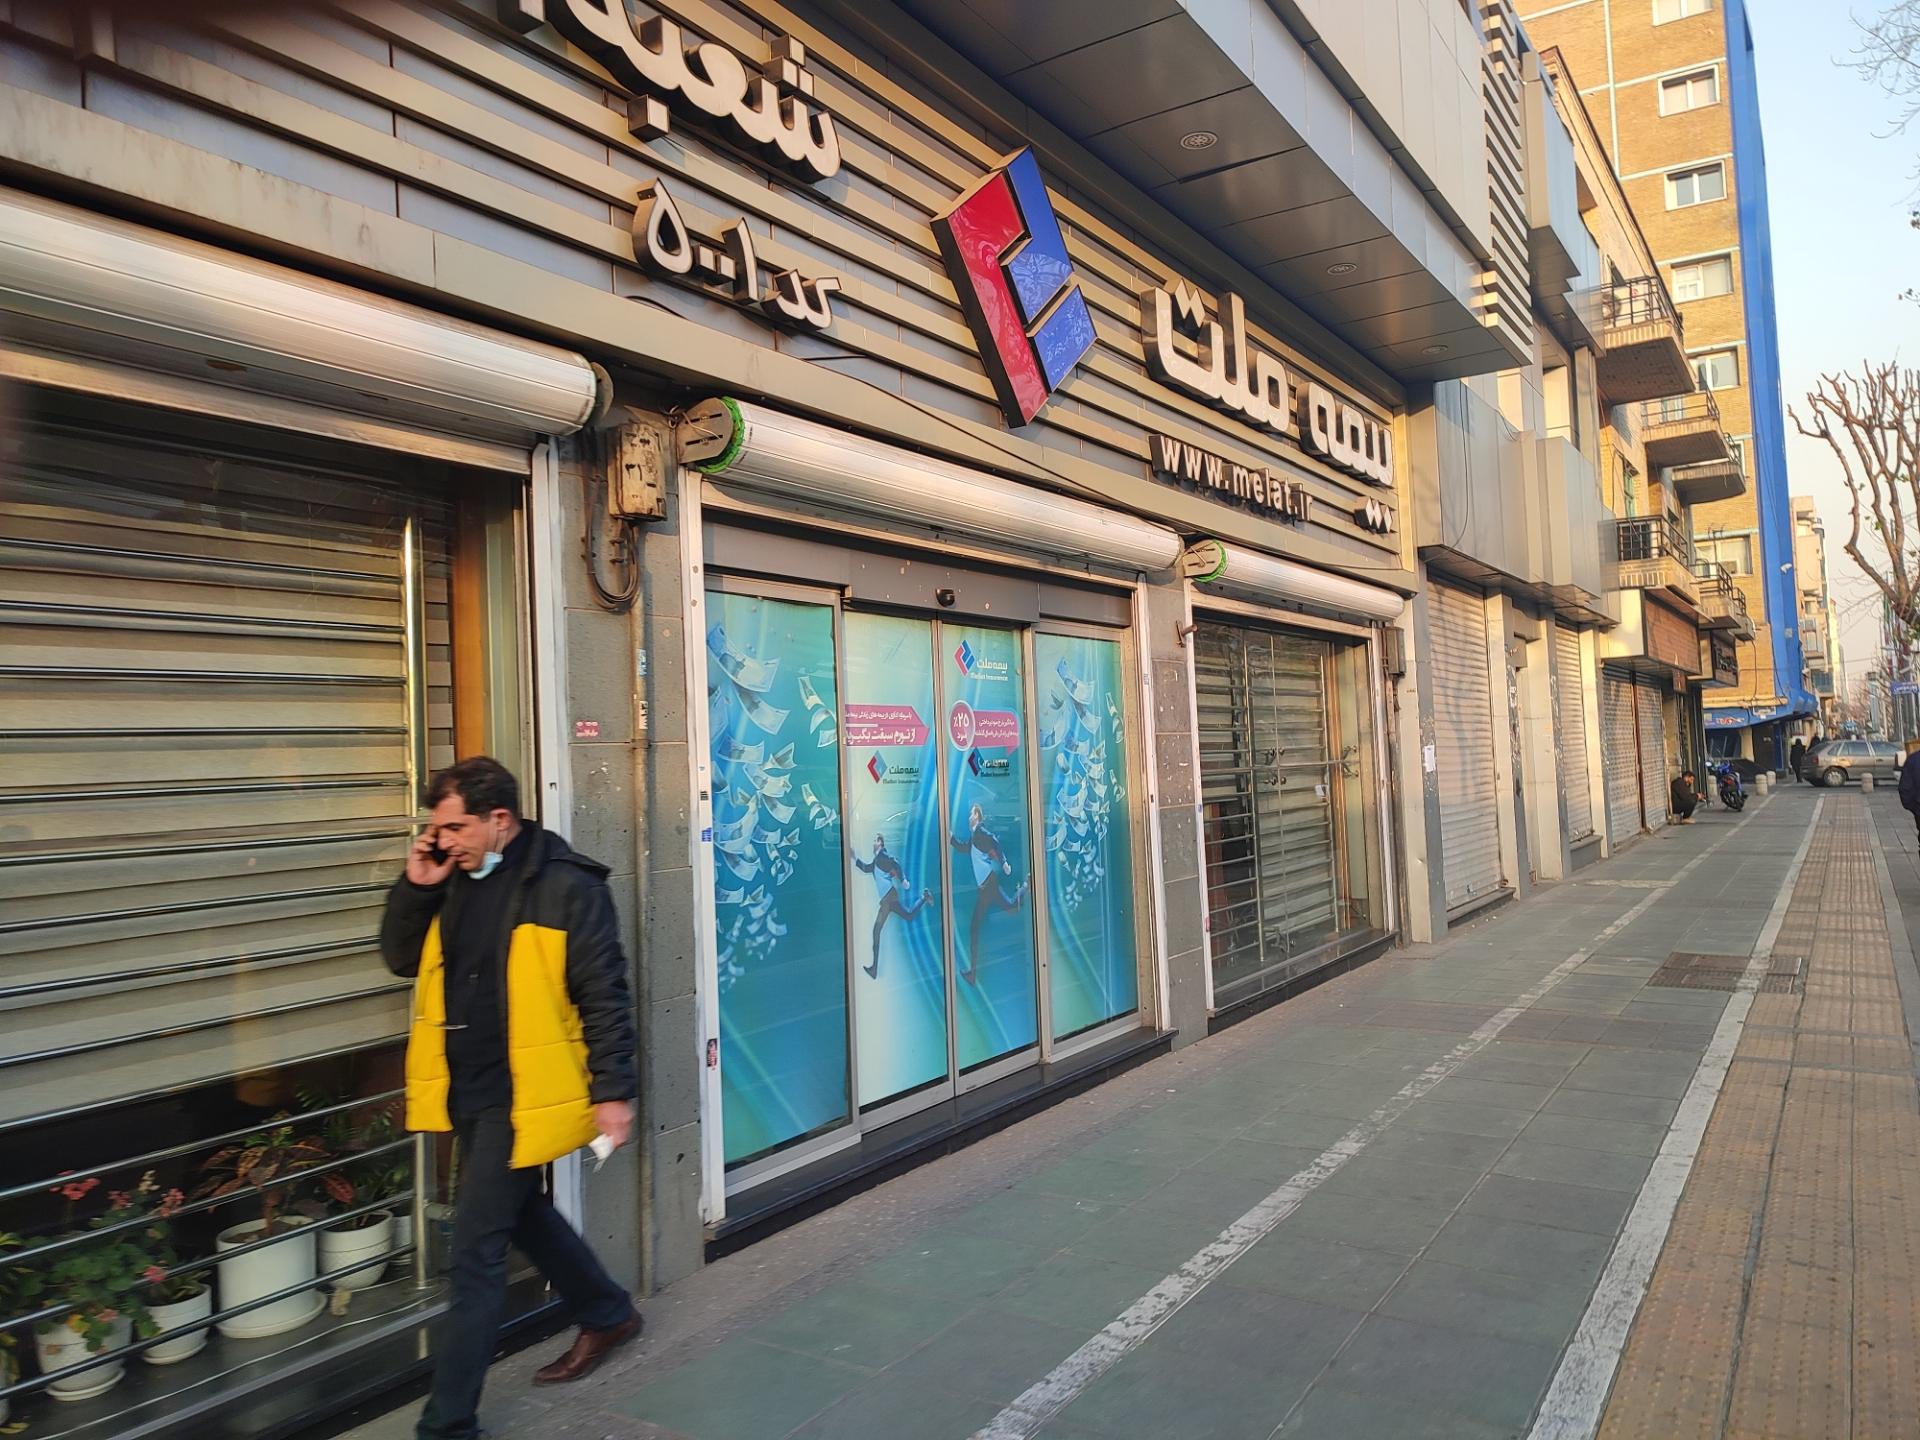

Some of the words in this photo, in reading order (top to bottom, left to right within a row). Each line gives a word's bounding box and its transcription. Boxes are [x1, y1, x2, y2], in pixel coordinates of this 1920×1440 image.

[1146, 278, 1291, 433] ملت
[1153, 433, 1313, 522] www.melat.ir
[1300, 381, 1395, 534] بیمه
[871, 728, 893, 742] سبقت
[889, 764, 904, 774] ملت
